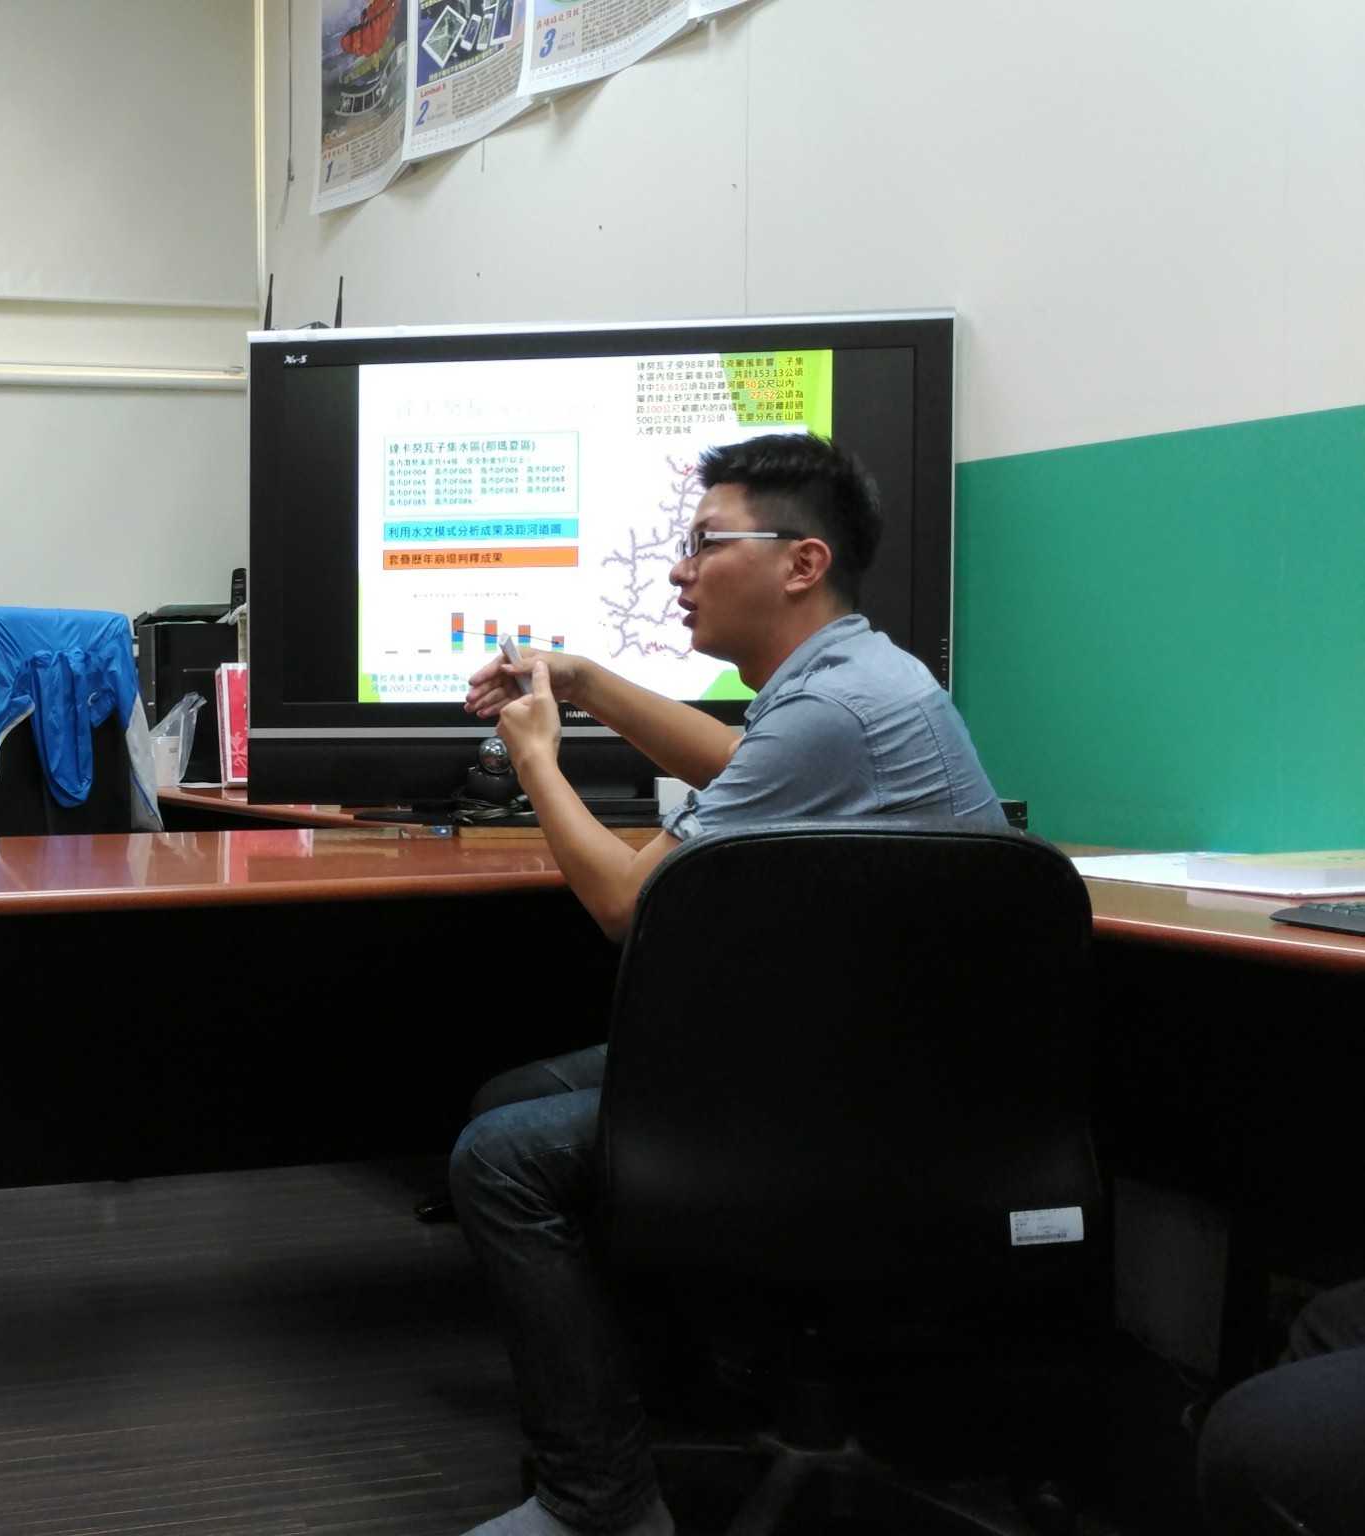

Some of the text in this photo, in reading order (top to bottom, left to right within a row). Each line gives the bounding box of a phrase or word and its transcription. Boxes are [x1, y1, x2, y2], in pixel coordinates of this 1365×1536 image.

[539, 28, 556, 58] 3
[421, 84, 442, 97] Landsat
[416, 99, 430, 126] 2
[325, 160, 334, 183] 1
[389, 523, 561, 538] 利用水文模式分析成果及距河道圖
[389, 552, 503, 566] 套疊歷年崩塌判釋成果
[566, 710, 593, 718] HANN
